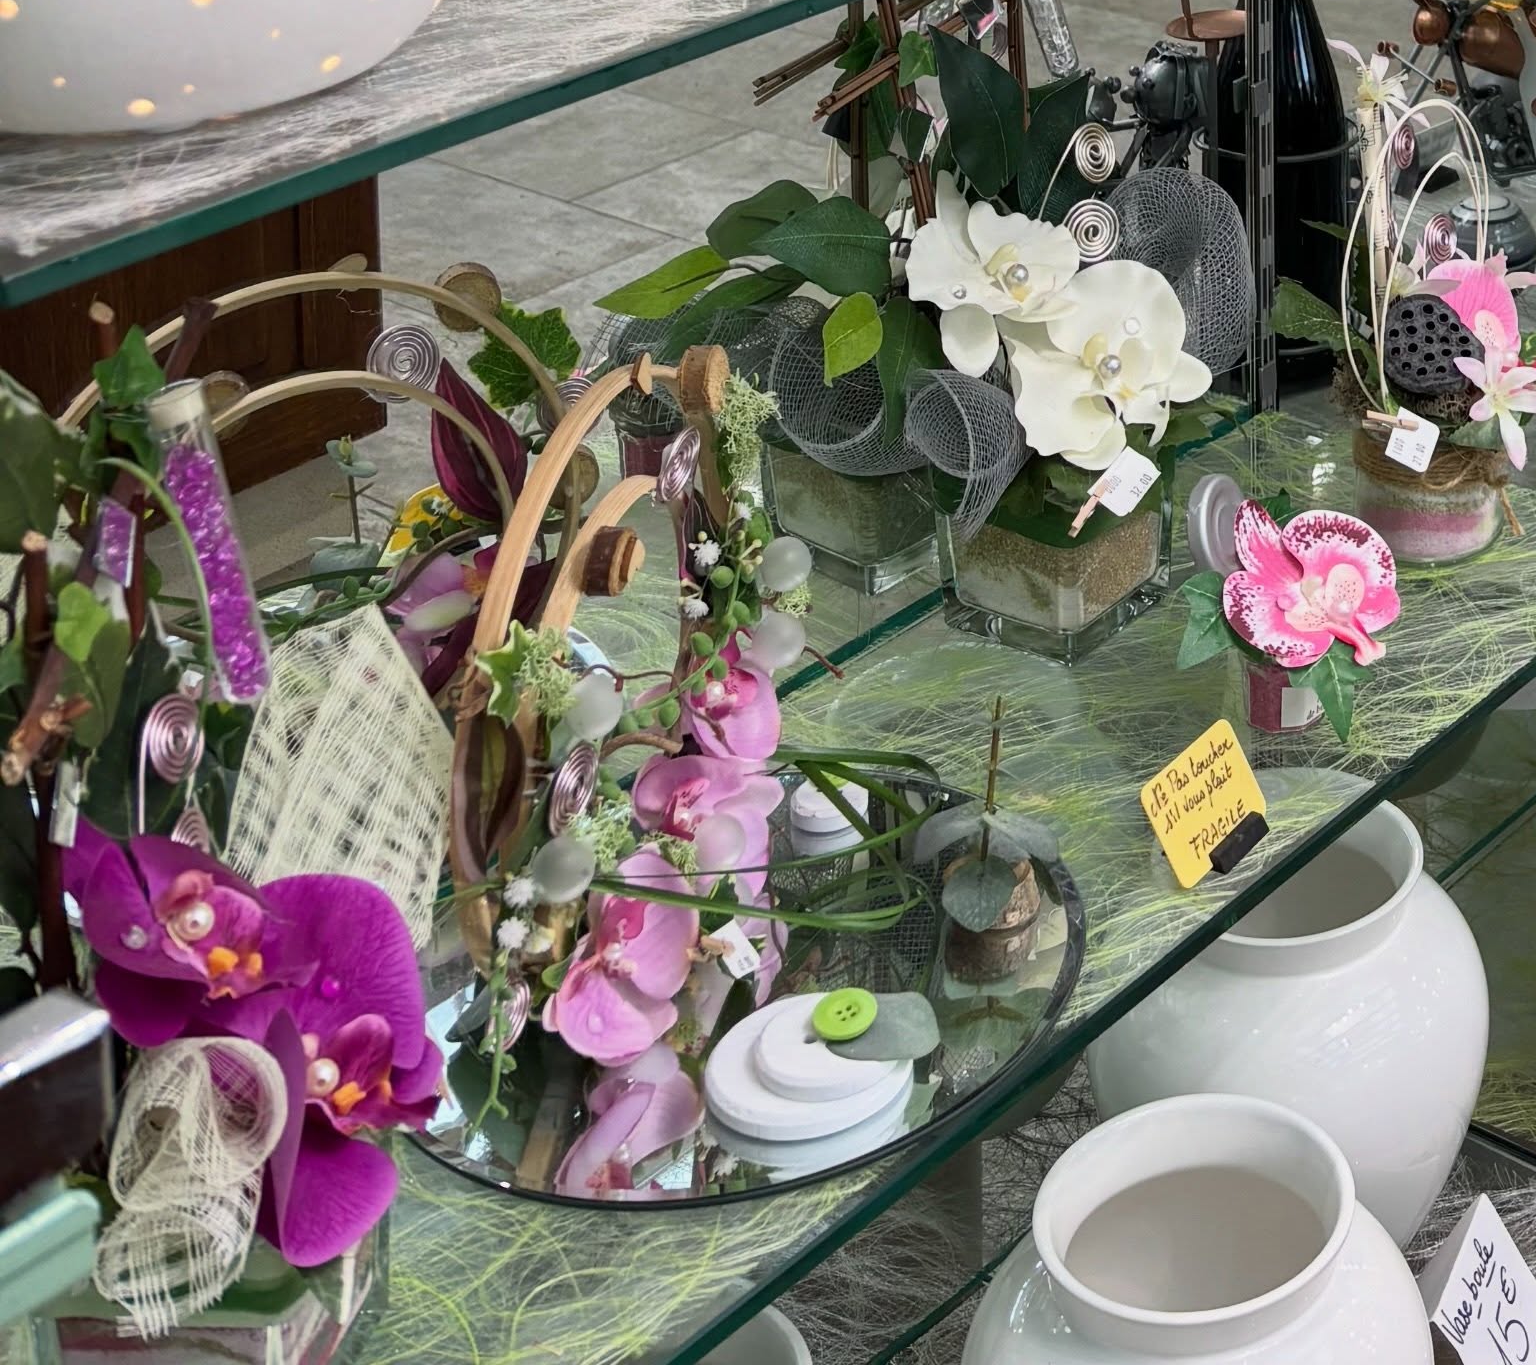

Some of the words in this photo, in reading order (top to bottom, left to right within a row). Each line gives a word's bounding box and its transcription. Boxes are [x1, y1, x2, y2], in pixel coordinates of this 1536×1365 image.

[1183, 788, 1206, 812] vous
[1441, 1299, 1473, 1345] Vase
[1461, 1237, 1495, 1301] boule
